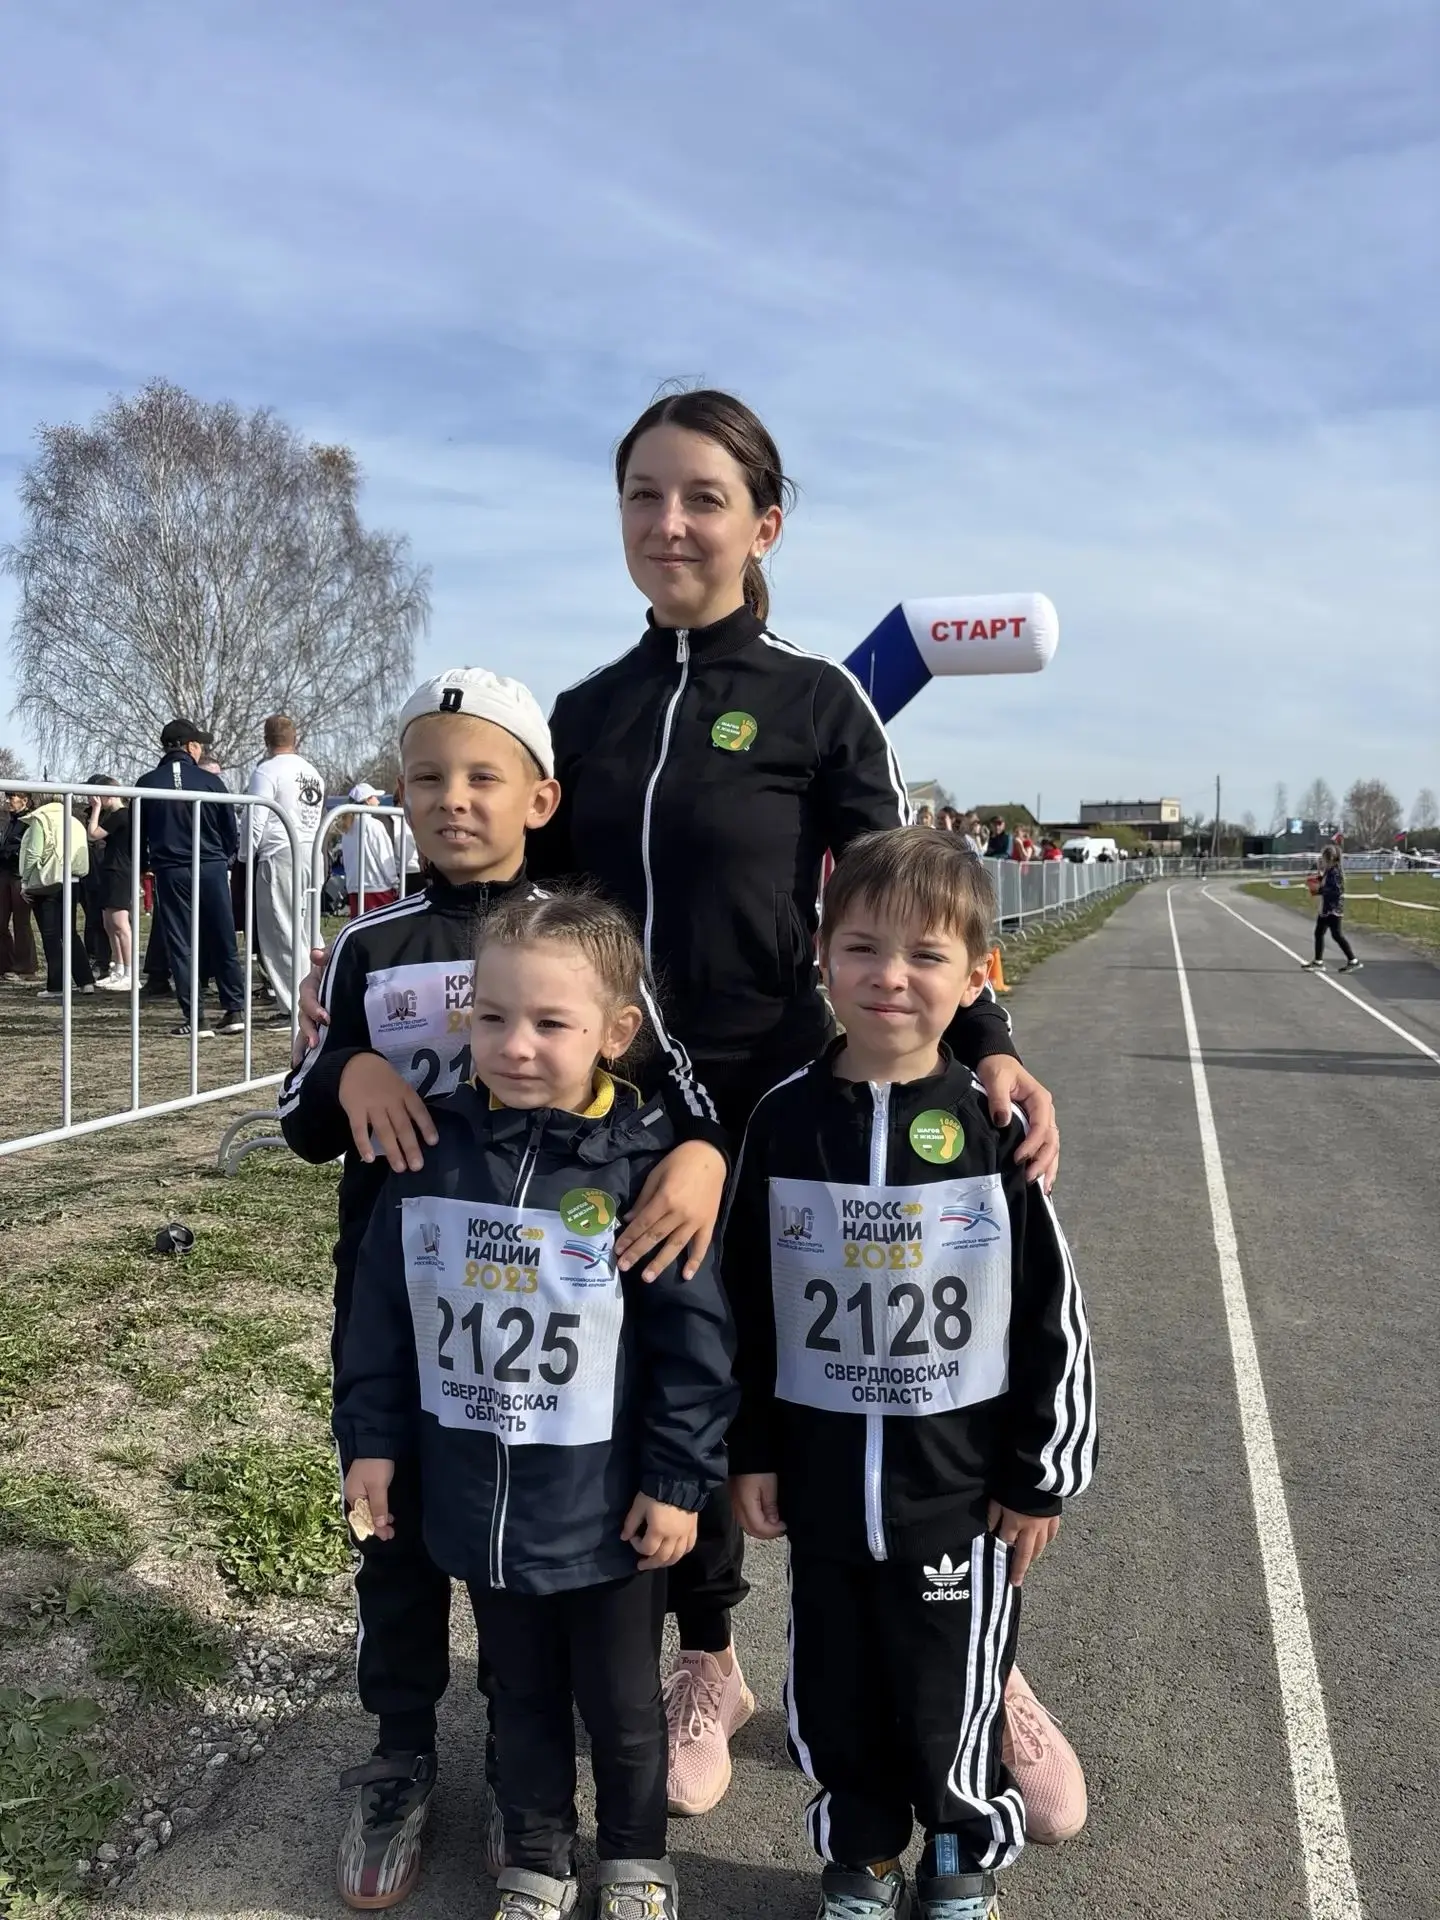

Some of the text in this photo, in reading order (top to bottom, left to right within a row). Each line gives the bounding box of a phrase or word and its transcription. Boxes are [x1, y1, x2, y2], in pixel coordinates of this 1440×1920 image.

[931, 617, 1026, 642] СТАРТ
[440, 687, 464, 712] D
[445, 975, 474, 991] КР
[842, 1199, 902, 1220] КРОСС
[468, 1218, 523, 1243] КРОСС
[843, 1221, 922, 1244] НАЦИИ
[465, 1239, 541, 1266] НАЦИИ
[843, 1243, 924, 1270] 2023
[462, 1261, 539, 1294] 2023
[803, 1275, 972, 1357] 2128
[437, 1295, 581, 1386] 2125
[824, 1360, 959, 1386] СВЕРДЛОВСКАЯ
[851, 1385, 933, 1405] ОБЛАСТЬ
[465, 1403, 527, 1432] ОБЛСТЬ
[922, 1587, 970, 1601] adidas
